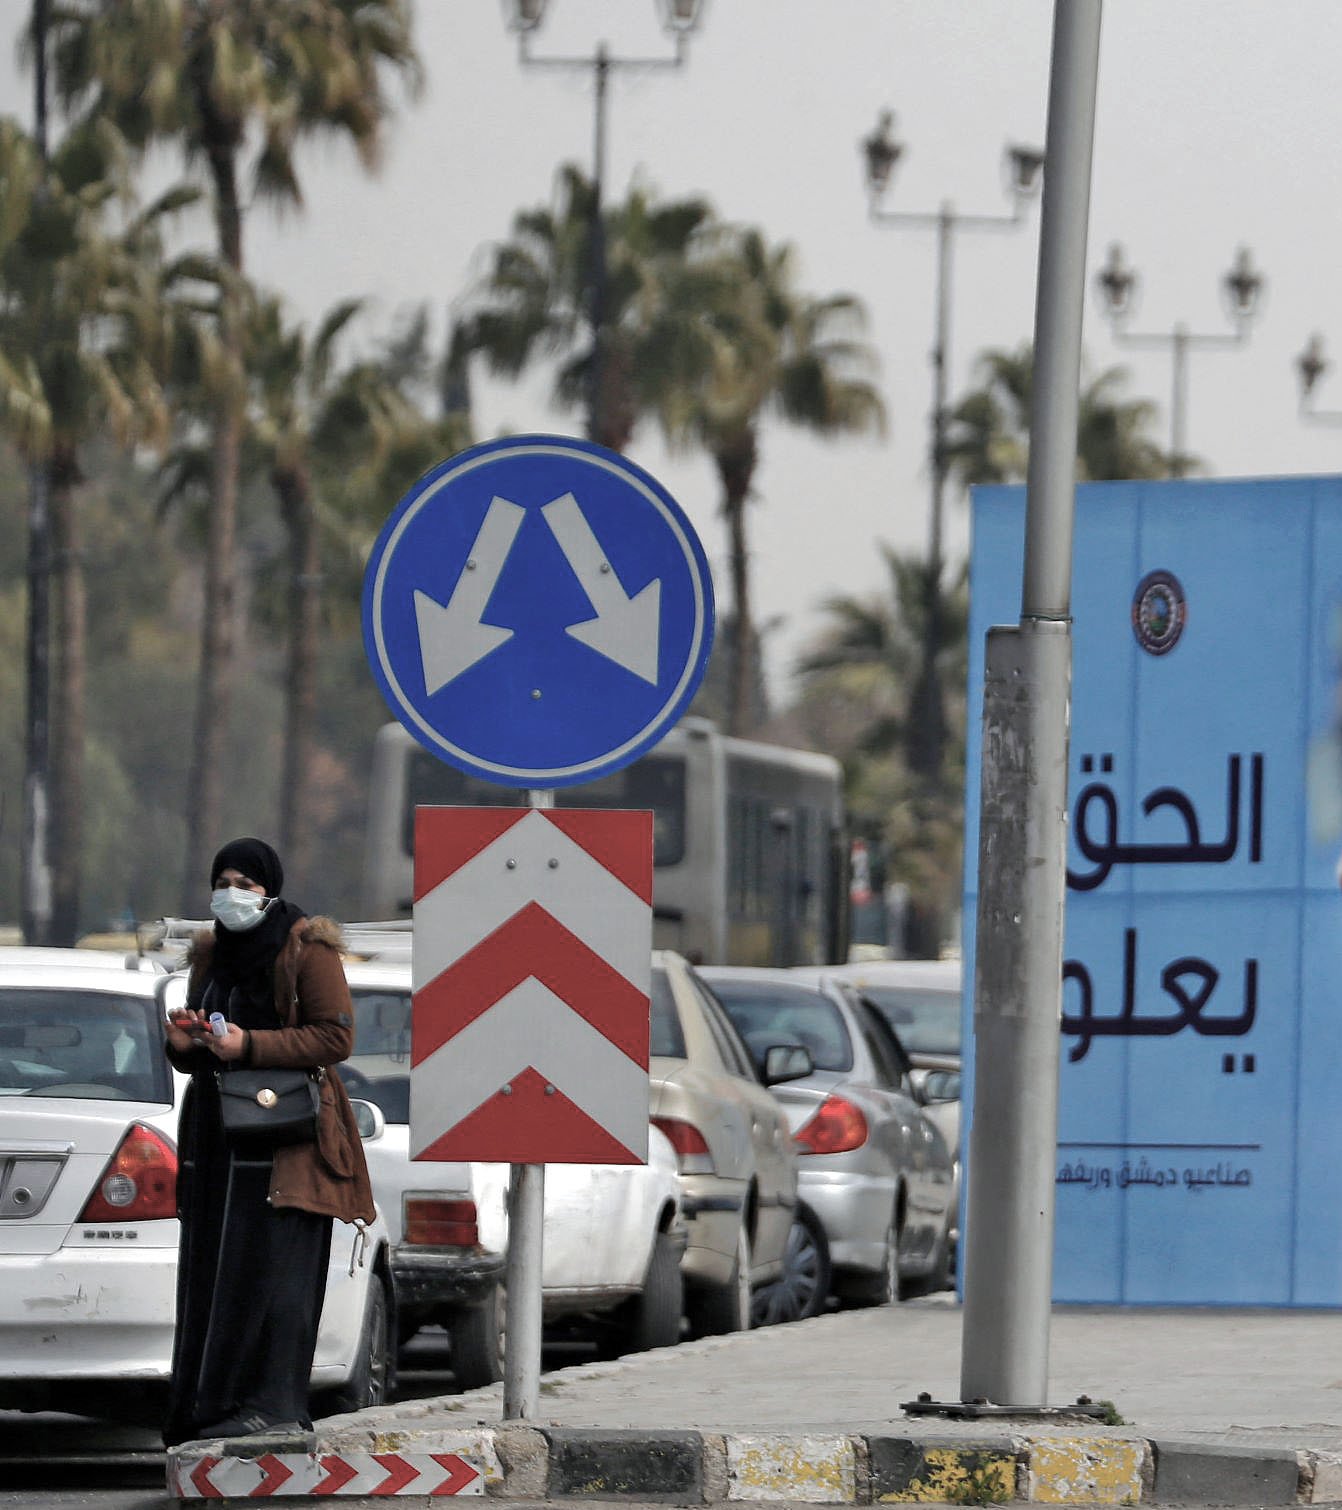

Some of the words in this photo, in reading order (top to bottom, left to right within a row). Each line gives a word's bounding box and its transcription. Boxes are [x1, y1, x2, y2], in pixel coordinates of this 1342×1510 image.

[1066, 753, 1264, 893] الحق
[1060, 928, 1258, 1074] يعلو
[1116, 1156, 1177, 1190] دمشق
